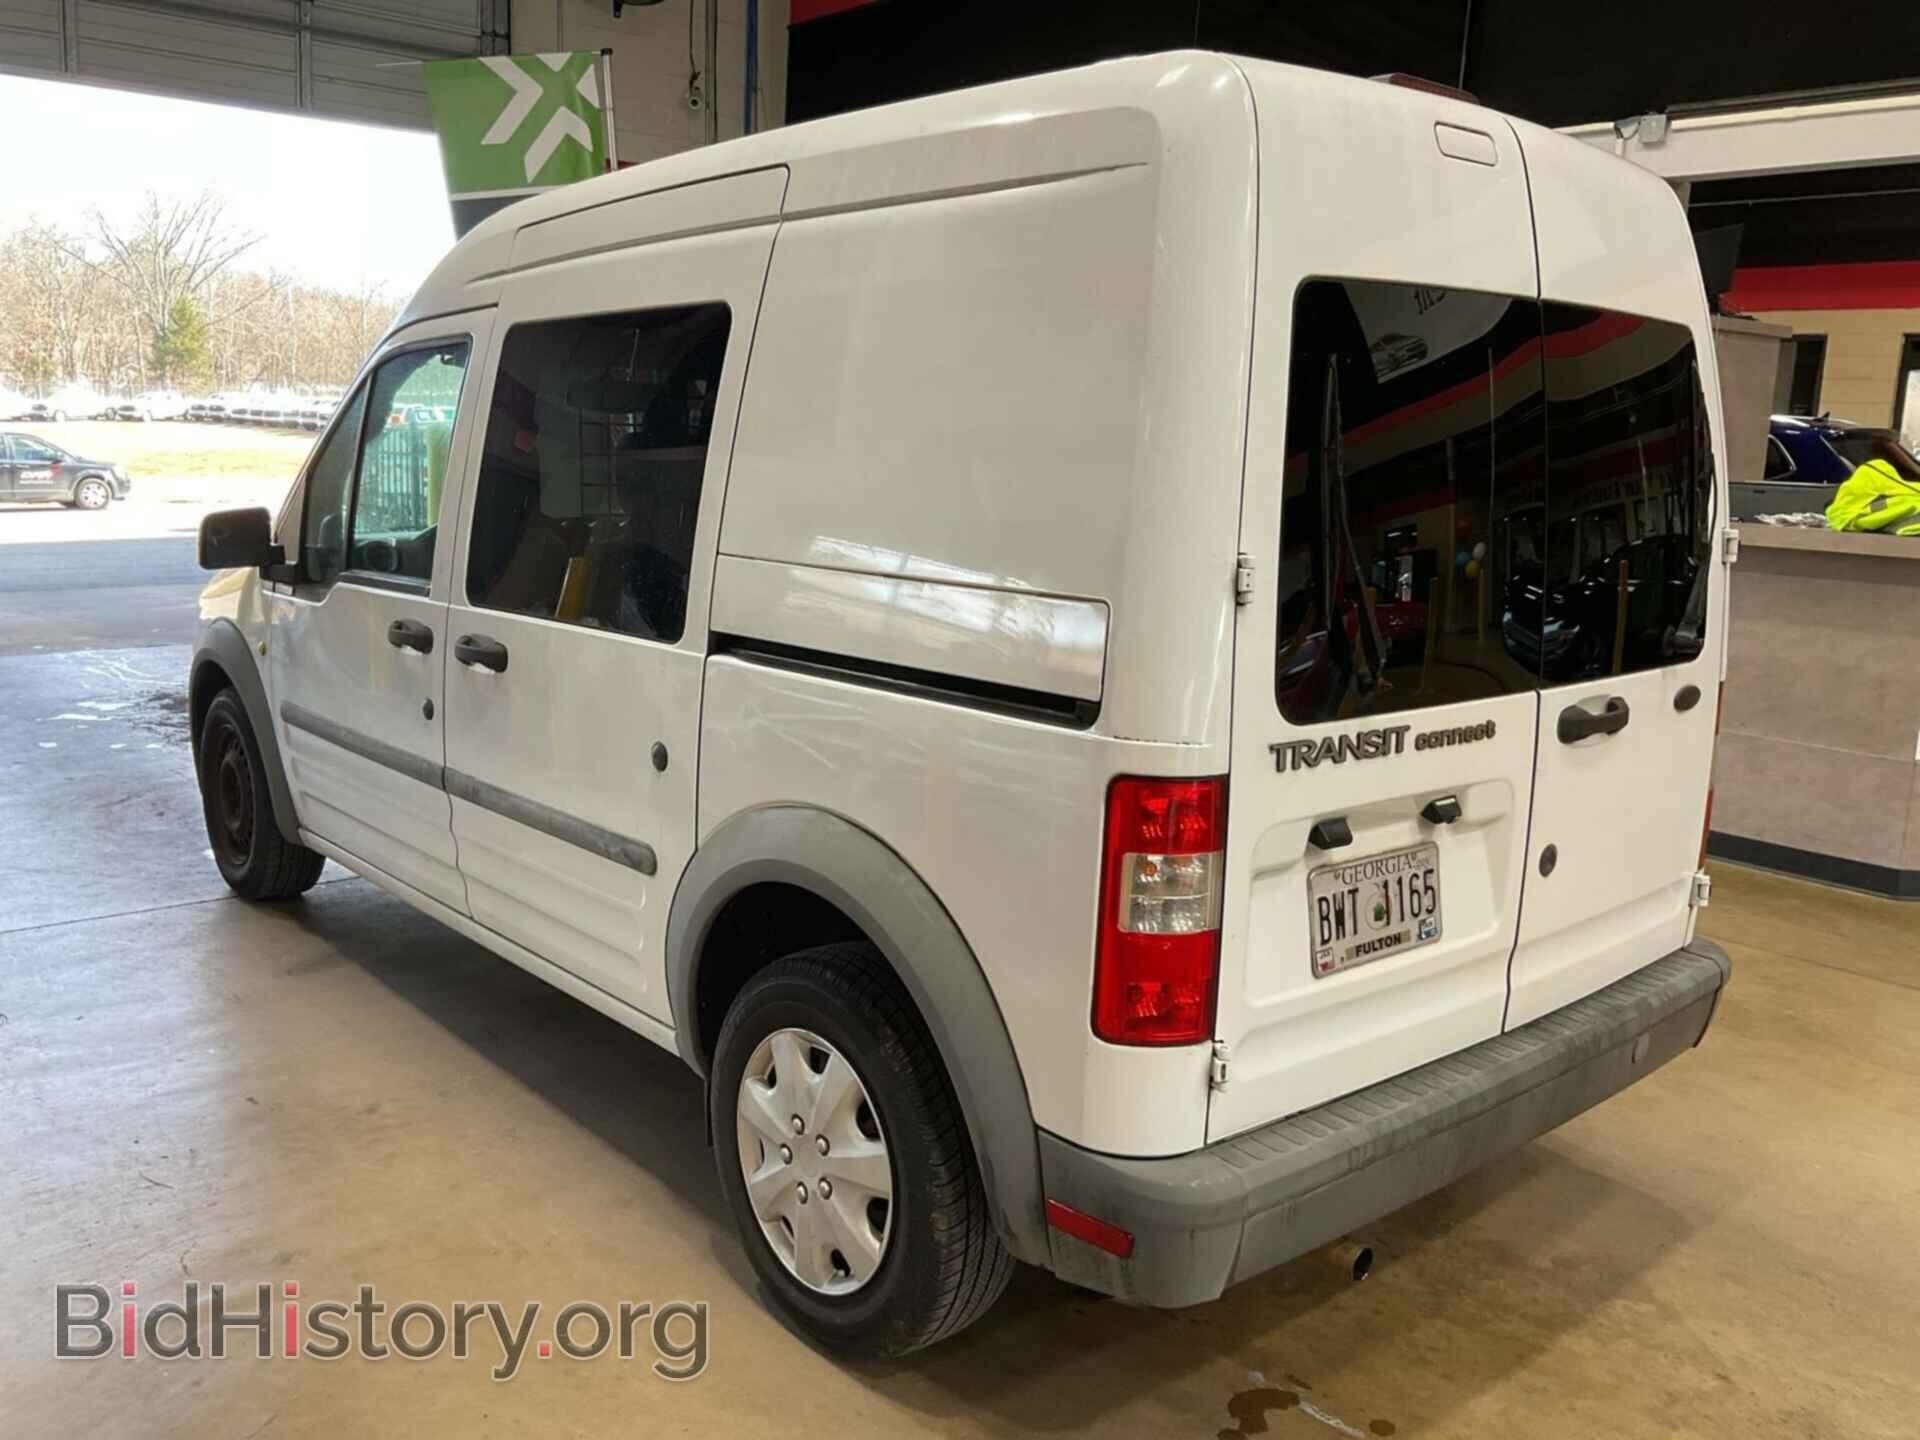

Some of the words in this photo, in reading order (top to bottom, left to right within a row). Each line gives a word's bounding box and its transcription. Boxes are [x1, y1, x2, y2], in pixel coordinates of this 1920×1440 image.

[1268, 725, 1411, 773] TRANSIT
[1414, 719, 1497, 751] connect
[1341, 853, 1412, 885] GEORGIA
[1317, 887, 1360, 946] BWT
[1383, 867, 1437, 927] 1165
[1354, 932, 1402, 958] FULTON
